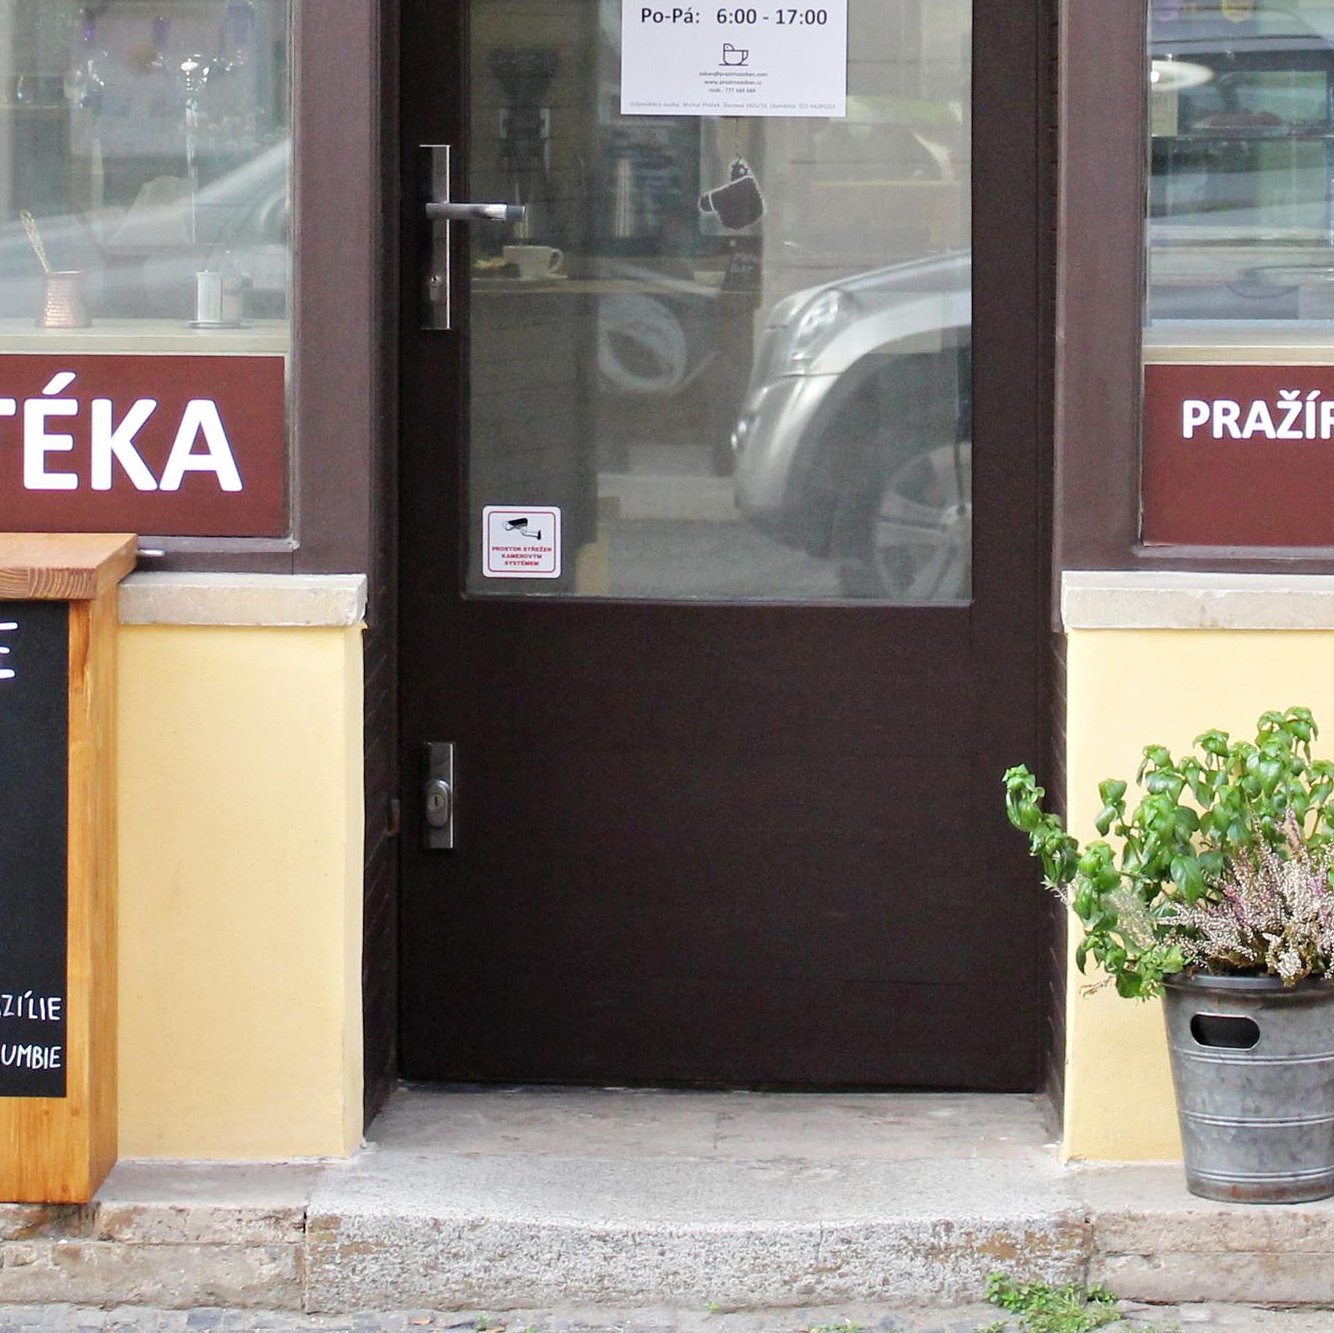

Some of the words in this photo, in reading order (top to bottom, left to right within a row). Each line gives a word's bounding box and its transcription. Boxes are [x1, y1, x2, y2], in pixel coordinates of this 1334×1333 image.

[641, 6, 700, 24] Po-Pá:
[716, 7, 757, 25] 6:00
[775, 8, 828, 26] 17:00
